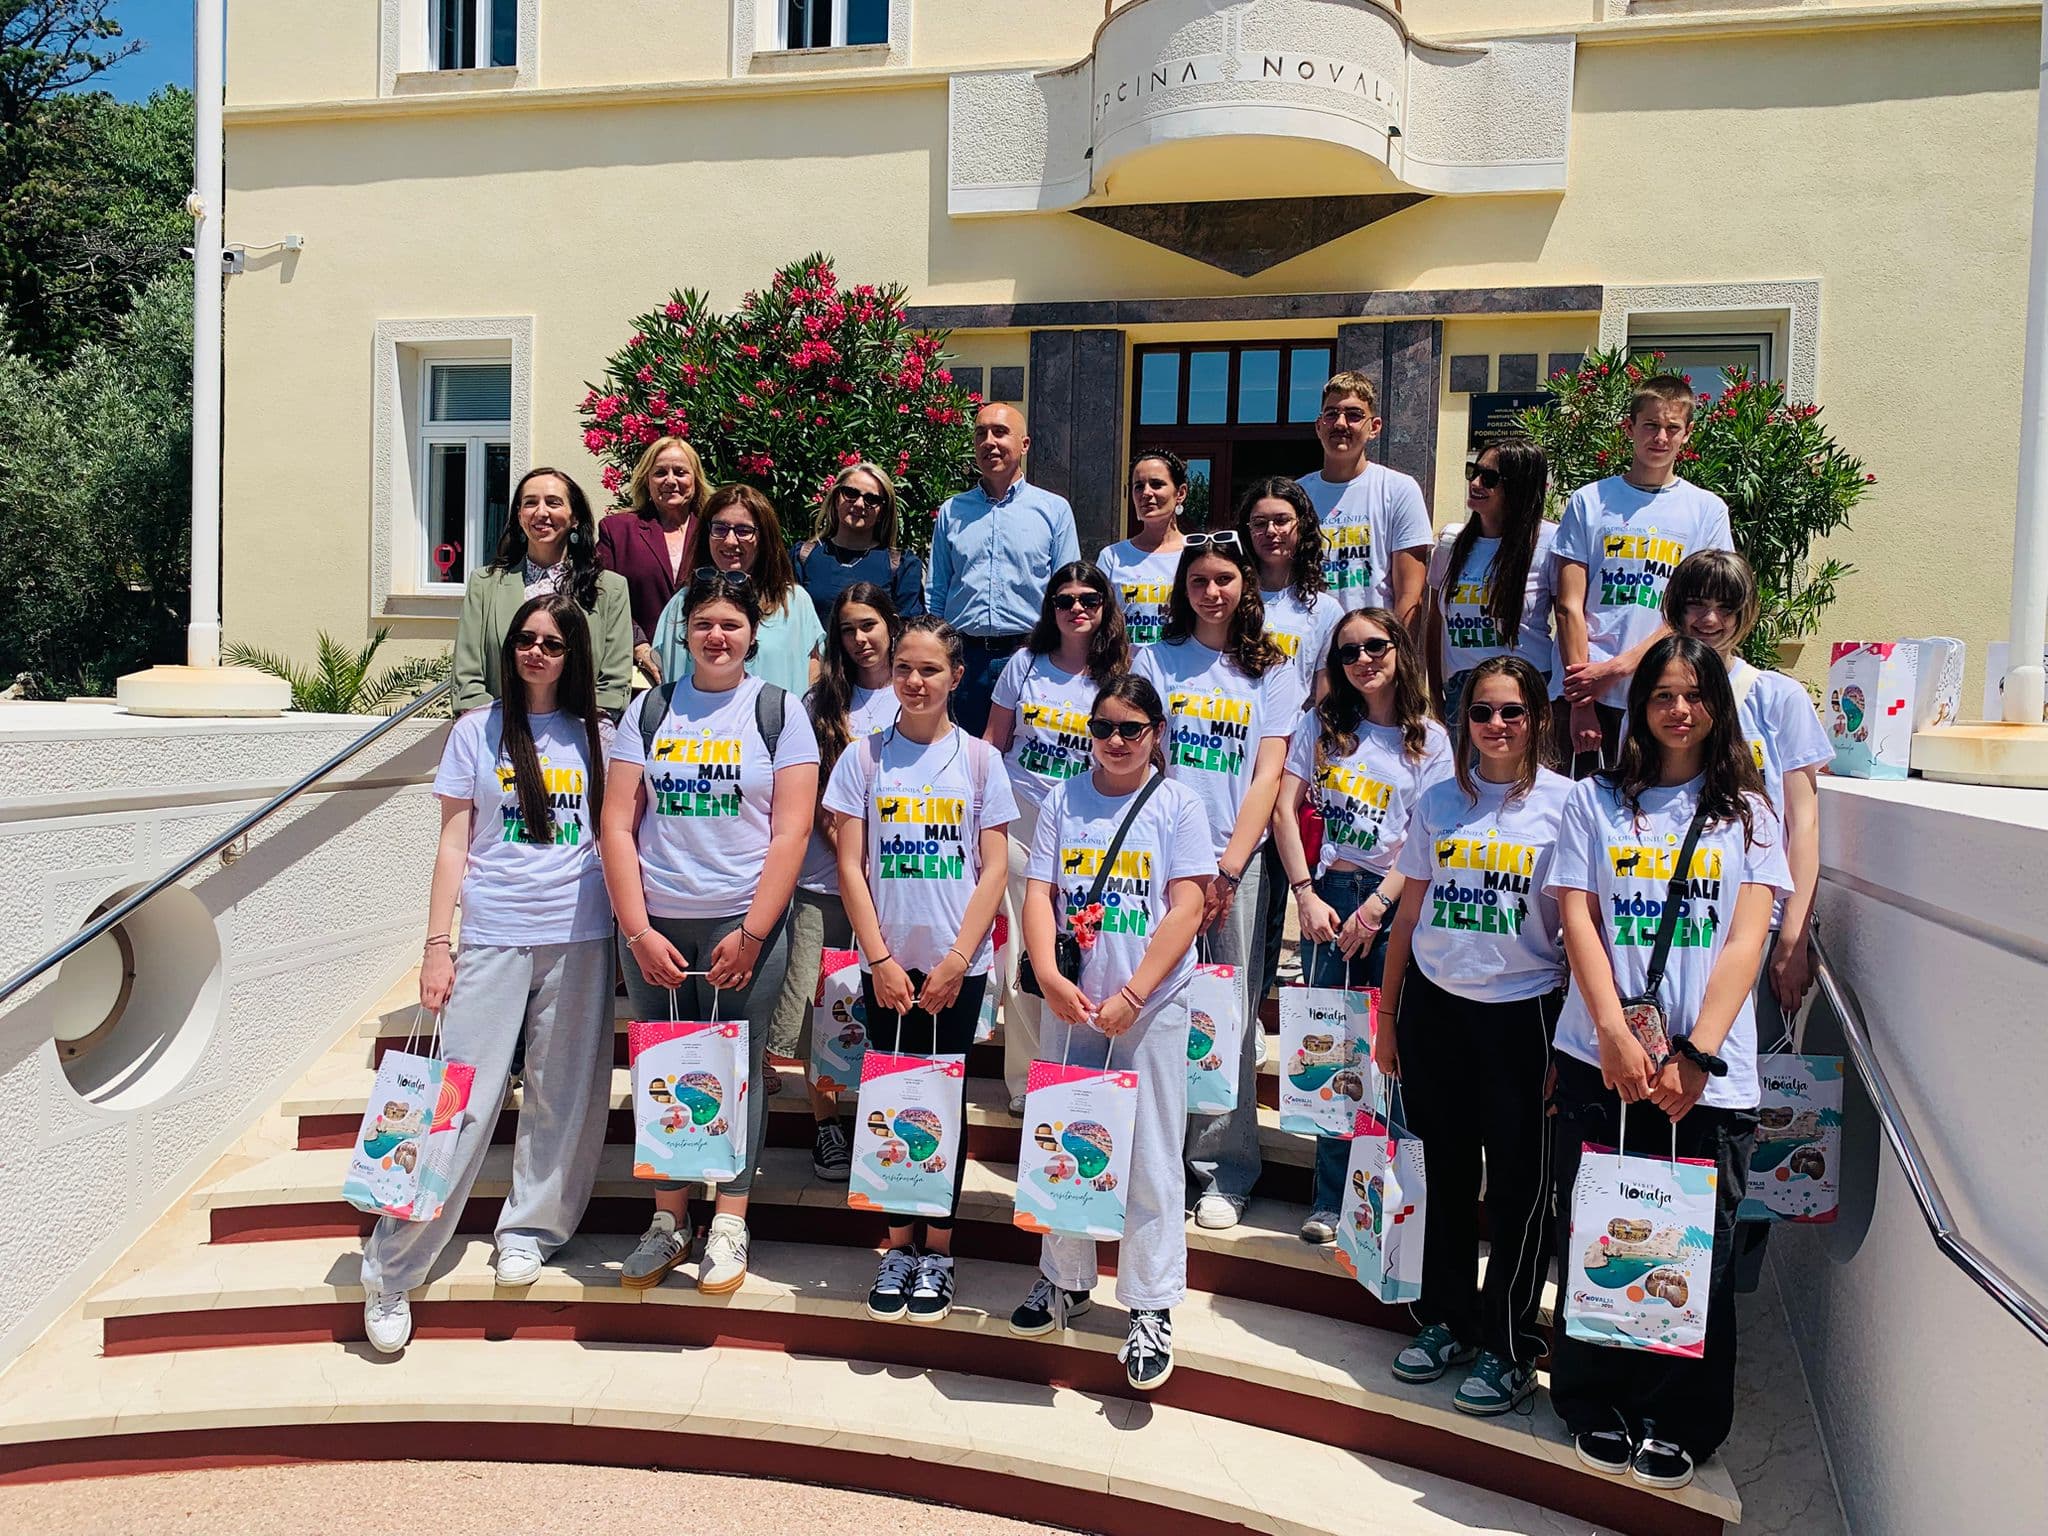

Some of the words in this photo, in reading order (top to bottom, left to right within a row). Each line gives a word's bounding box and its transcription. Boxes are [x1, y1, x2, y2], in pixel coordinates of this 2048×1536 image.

[1339, 546, 1370, 560] MALI
[1604, 535, 1685, 566] VELIKI
[1600, 584, 1664, 609] ZELEN
[1023, 703, 1092, 737] VELIK
[1169, 693, 1252, 725] VELIKI
[1057, 732, 1092, 752] MALI
[1210, 721, 1248, 741] MALI
[655, 738, 742, 764] VELIKI
[1026, 740, 1067, 758] ODRO
[1170, 742, 1242, 776] ZELENI
[698, 764, 741, 780] MALI
[656, 792, 741, 817] ZELENI
[876, 796, 965, 824] VELIKI
[1346, 796, 1385, 824] MALI
[925, 824, 962, 841] MALI
[880, 840, 939, 855] MODRO
[1435, 839, 1536, 876] VELIKI
[880, 855, 963, 880] ZELENI
[1107, 877, 1150, 897] MALI
[1433, 884, 1498, 905] MODRO
[1484, 871, 1531, 894] MALI
[1431, 901, 1527, 936] ZELENI
[1614, 900, 1690, 918] MODO
[1763, 1076, 1808, 1096] Novalja
[1620, 1182, 1672, 1208] Novalja
